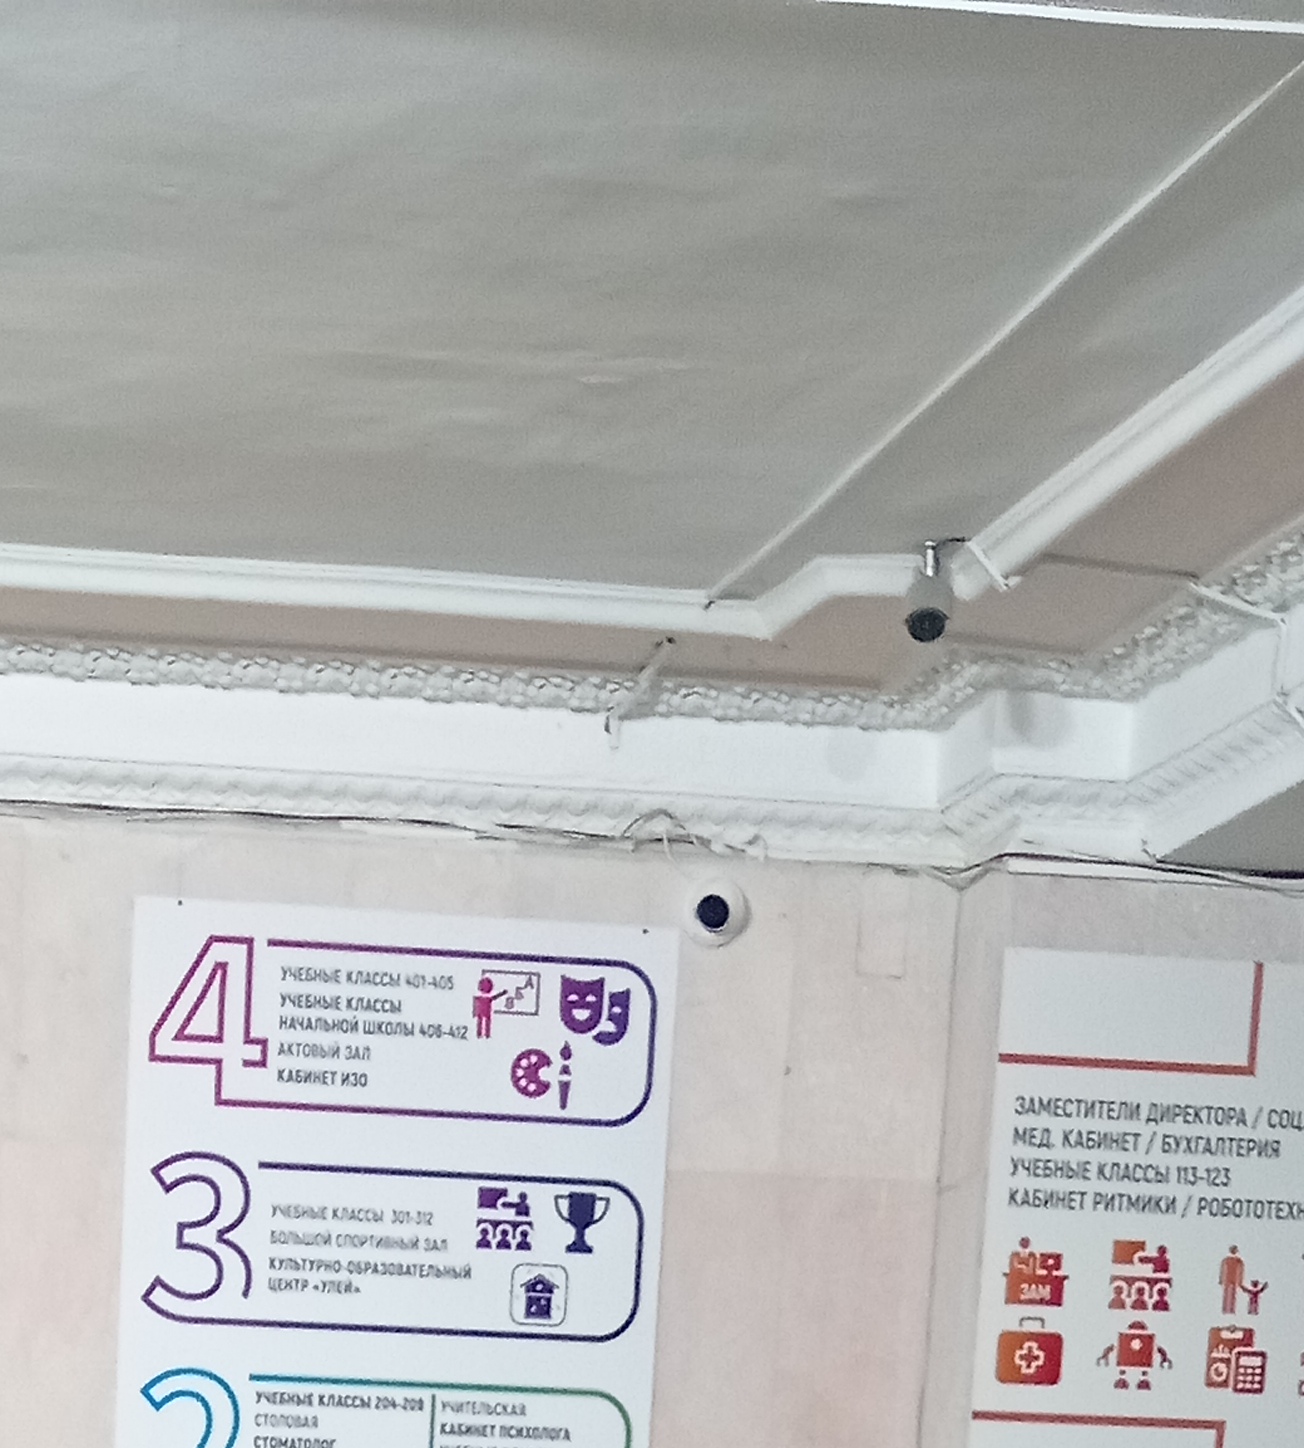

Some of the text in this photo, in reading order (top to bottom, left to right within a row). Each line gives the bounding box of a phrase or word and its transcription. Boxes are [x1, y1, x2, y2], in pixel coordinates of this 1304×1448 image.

[280, 966, 342, 984] УЧЕБНЫЕ
[347, 970, 401, 987] КЛАССЫ
[279, 993, 402, 1013] УЧЕБНЫЕ КЛАССЫ
[149, 934, 269, 1106] 4
[279, 1015, 359, 1034] НАЧАЛЬНОЙ
[363, 1020, 415, 1036] ШКОЛЫ
[277, 1041, 371, 1061] АКТОВЫЙ ЗАЛ
[277, 1068, 368, 1087] КАБИНЕТ ИЗО
[1014, 1095, 1141, 1121] ЗАМЕСТИТЕЛИ
[1145, 1101, 1247, 1128] ДИРЕКТОРА
[1012, 1127, 1055, 1149] МЕД.
[1062, 1128, 1142, 1152] КАБИНЕТ
[1161, 1133, 1281, 1159] БУХГАЛТЕРИЯ
[1010, 1156, 1231, 1187] УЧЕБНЫЕ КЛАССЫ 113-123
[1008, 1187, 1087, 1210] КАБИНЕТ
[1092, 1191, 1177, 1215] РИТМИКИ
[270, 1204, 328, 1221] УЧЕБНЫЕ
[332, 1207, 384, 1223] КЛАССЫ
[141, 1150, 252, 1323] 3
[270, 1229, 448, 1252] БОЛЬШОЙ СПОРТИВНЫЙ ЗАЛ
[268, 1277, 308, 1293] ЦЕНТР
[1020, 1283, 1051, 1300] ЗАМ
[255, 1391, 314, 1407] УЧЕБНЫЕ
[318, 1393, 371, 1409] КЛАССЫ
[441, 1400, 527, 1416] УЧИТЕЛЬСКАЯ
[254, 1413, 319, 1428] СТОЛОВАЯ
[440, 1422, 571, 1442] КАБИНЕТ ПСИХОЛОГА
